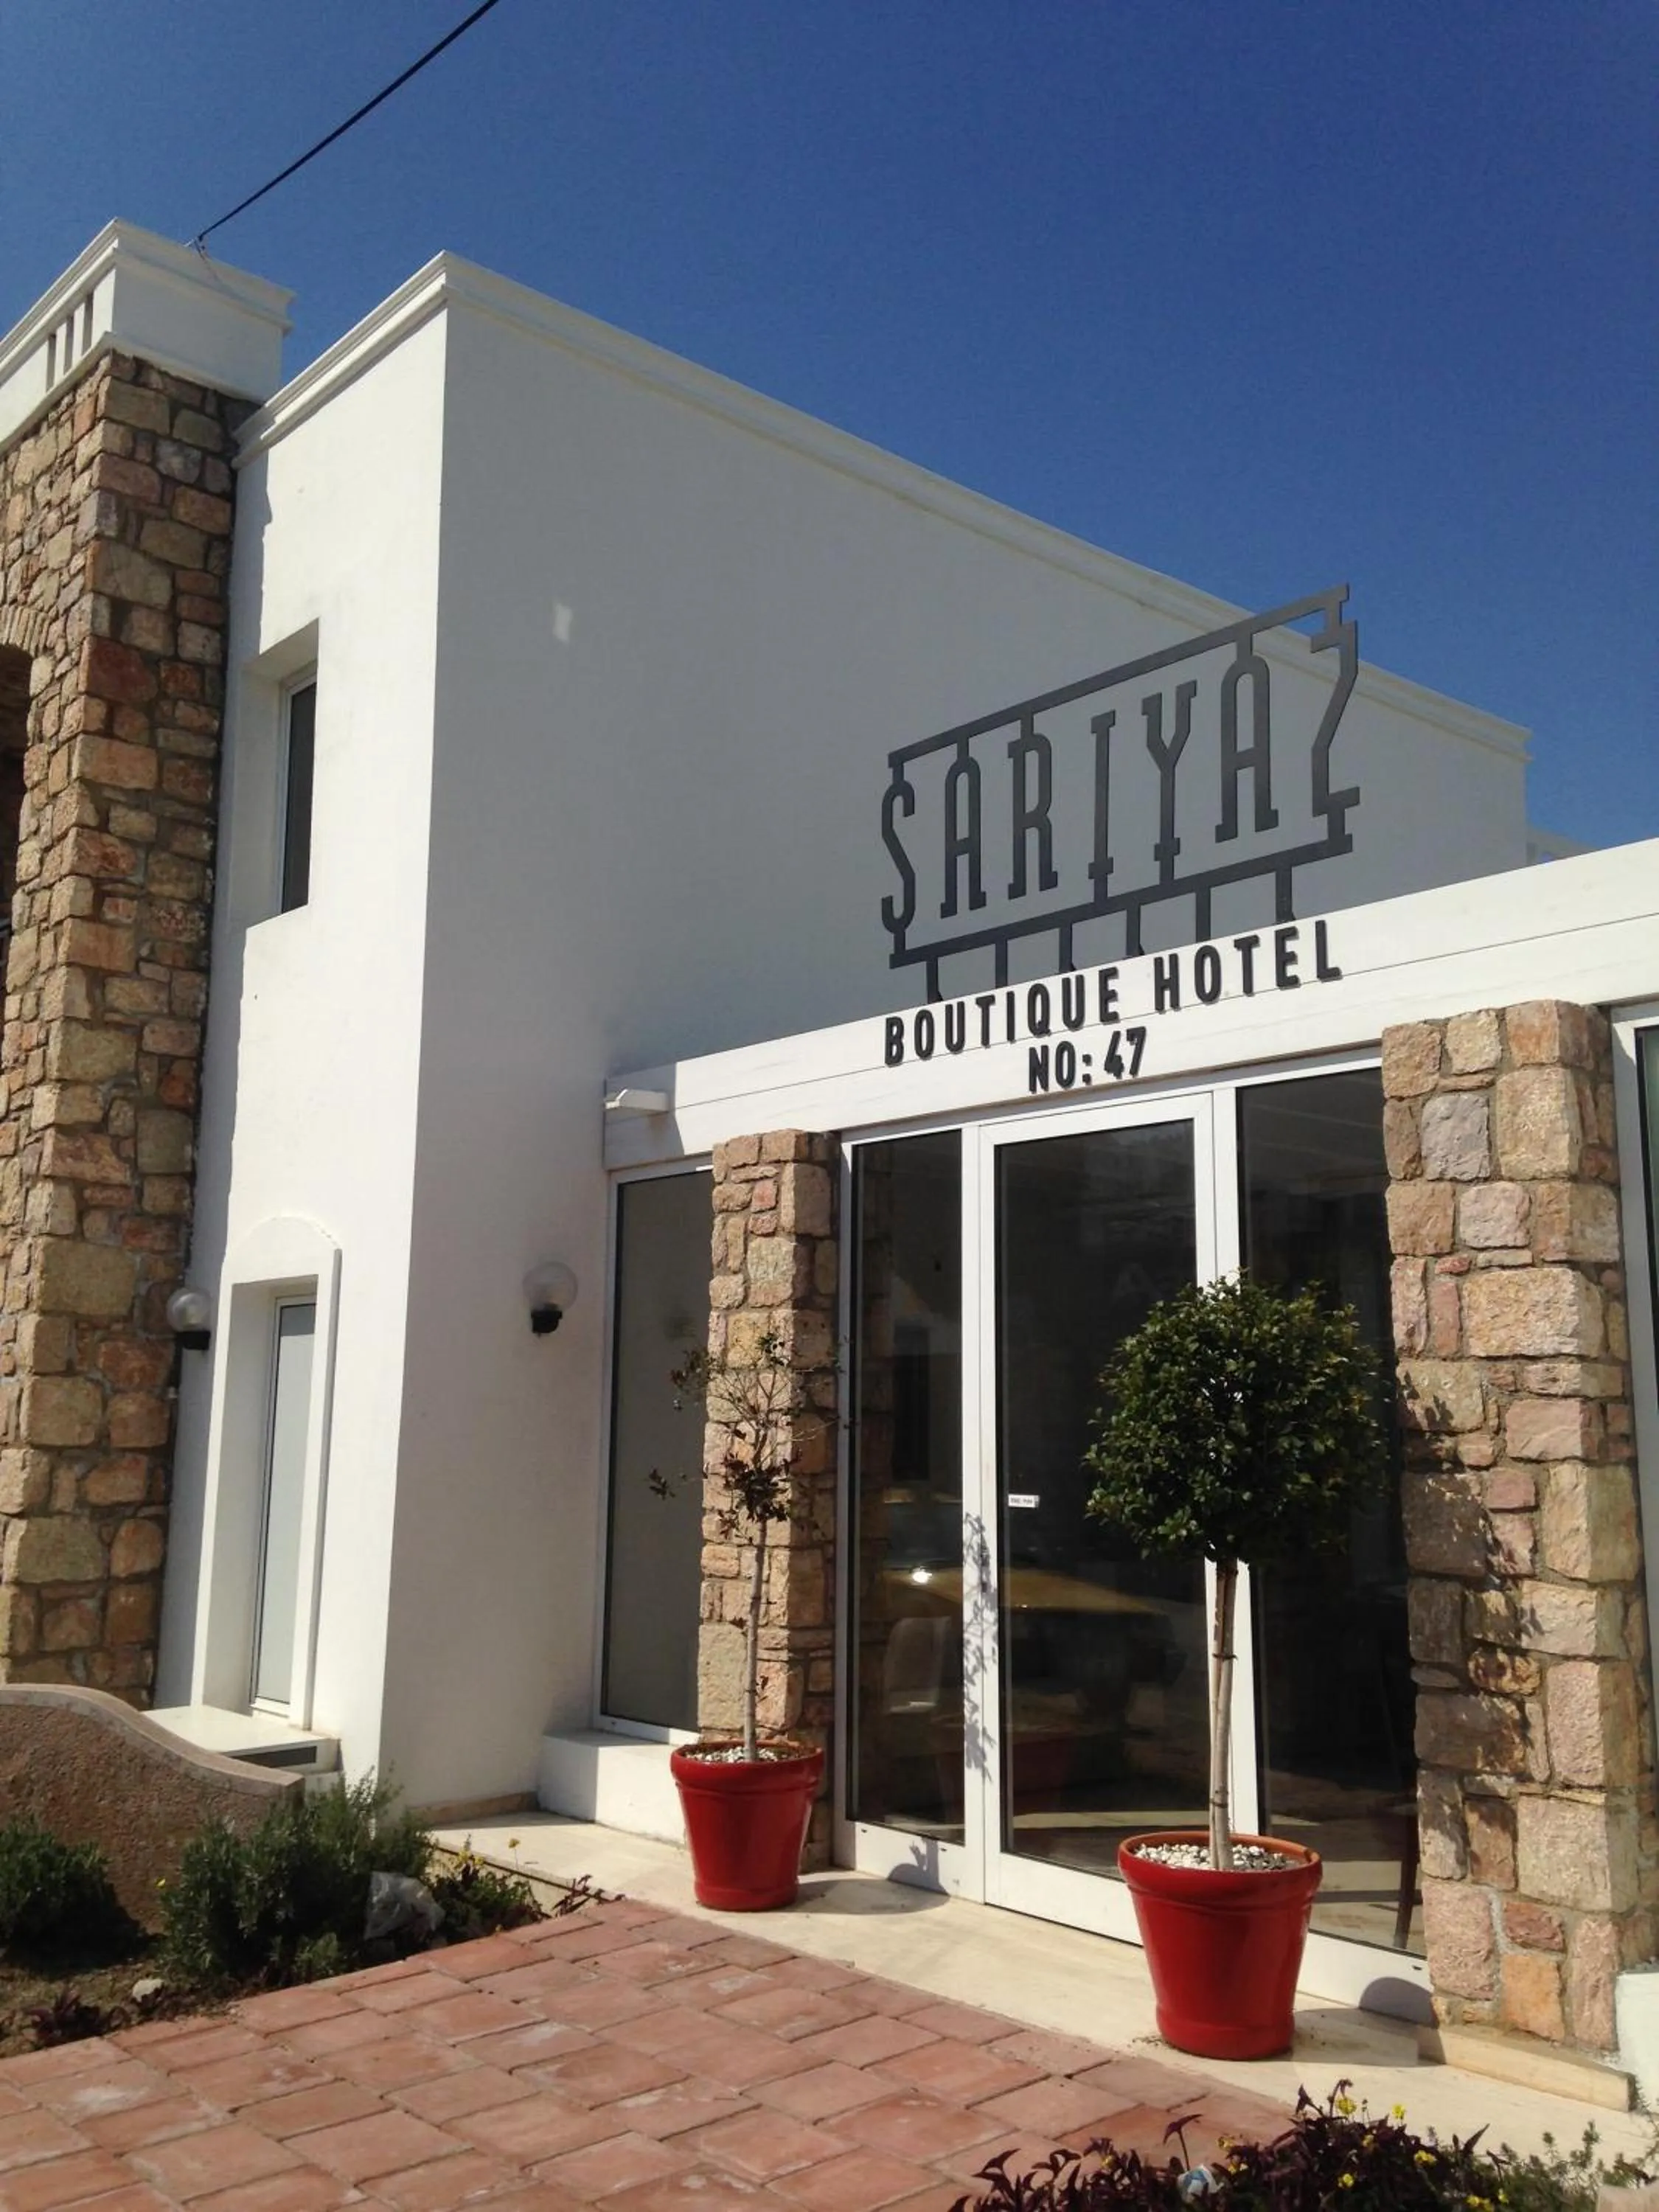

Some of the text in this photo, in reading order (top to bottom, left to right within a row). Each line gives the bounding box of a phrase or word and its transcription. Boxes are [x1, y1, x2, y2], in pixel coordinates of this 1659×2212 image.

[882, 618, 1360, 935] SARIYAZ
[885, 920, 1342, 1067] BOUTIQUE HOTEL
